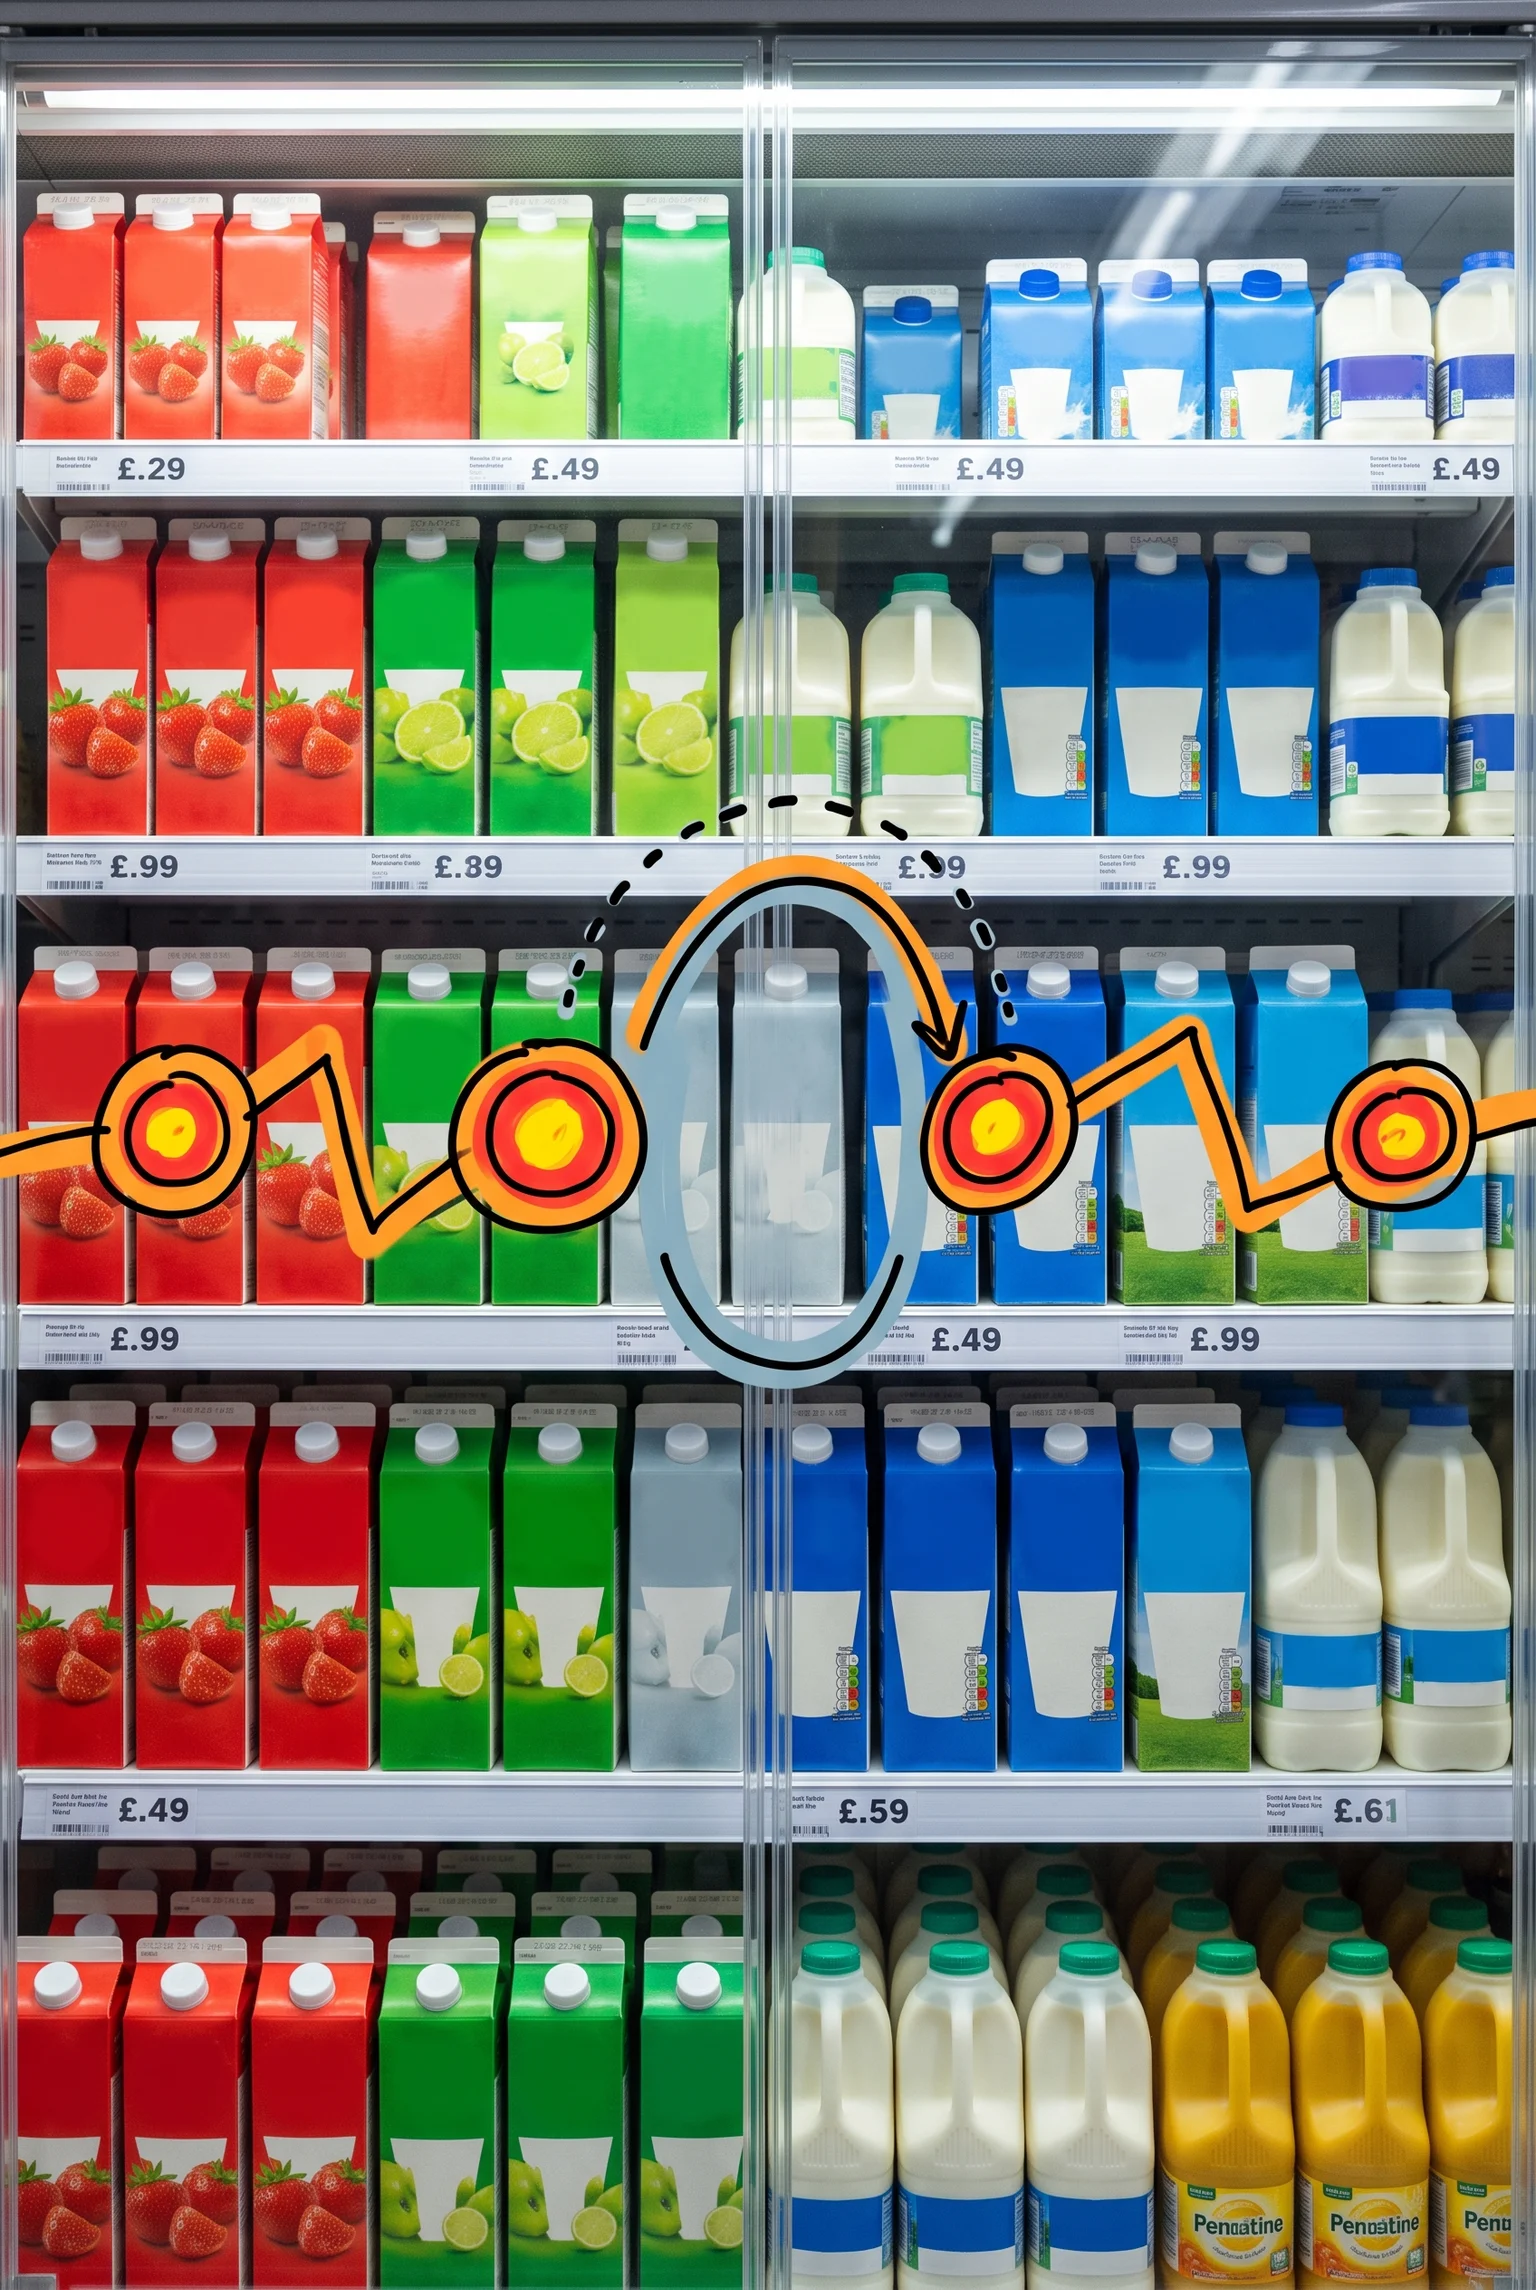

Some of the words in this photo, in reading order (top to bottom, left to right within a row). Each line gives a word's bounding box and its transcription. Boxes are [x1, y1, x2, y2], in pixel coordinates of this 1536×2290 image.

[118, 457, 185, 480] £.29
[532, 458, 599, 480] £.49
[957, 458, 1023, 480] £.49
[1433, 458, 1499, 480] £.49
[111, 855, 178, 878] £.99
[435, 855, 502, 878] £.89
[1163, 855, 1230, 879] £.99
[111, 1327, 178, 1351] £.99
[932, 1327, 1001, 1351] £.49
[1191, 1327, 1259, 1351] £.99
[119, 1798, 188, 1822] £.49
[839, 1799, 908, 1823] £.59
[1334, 1798, 1397, 1823] £.61
